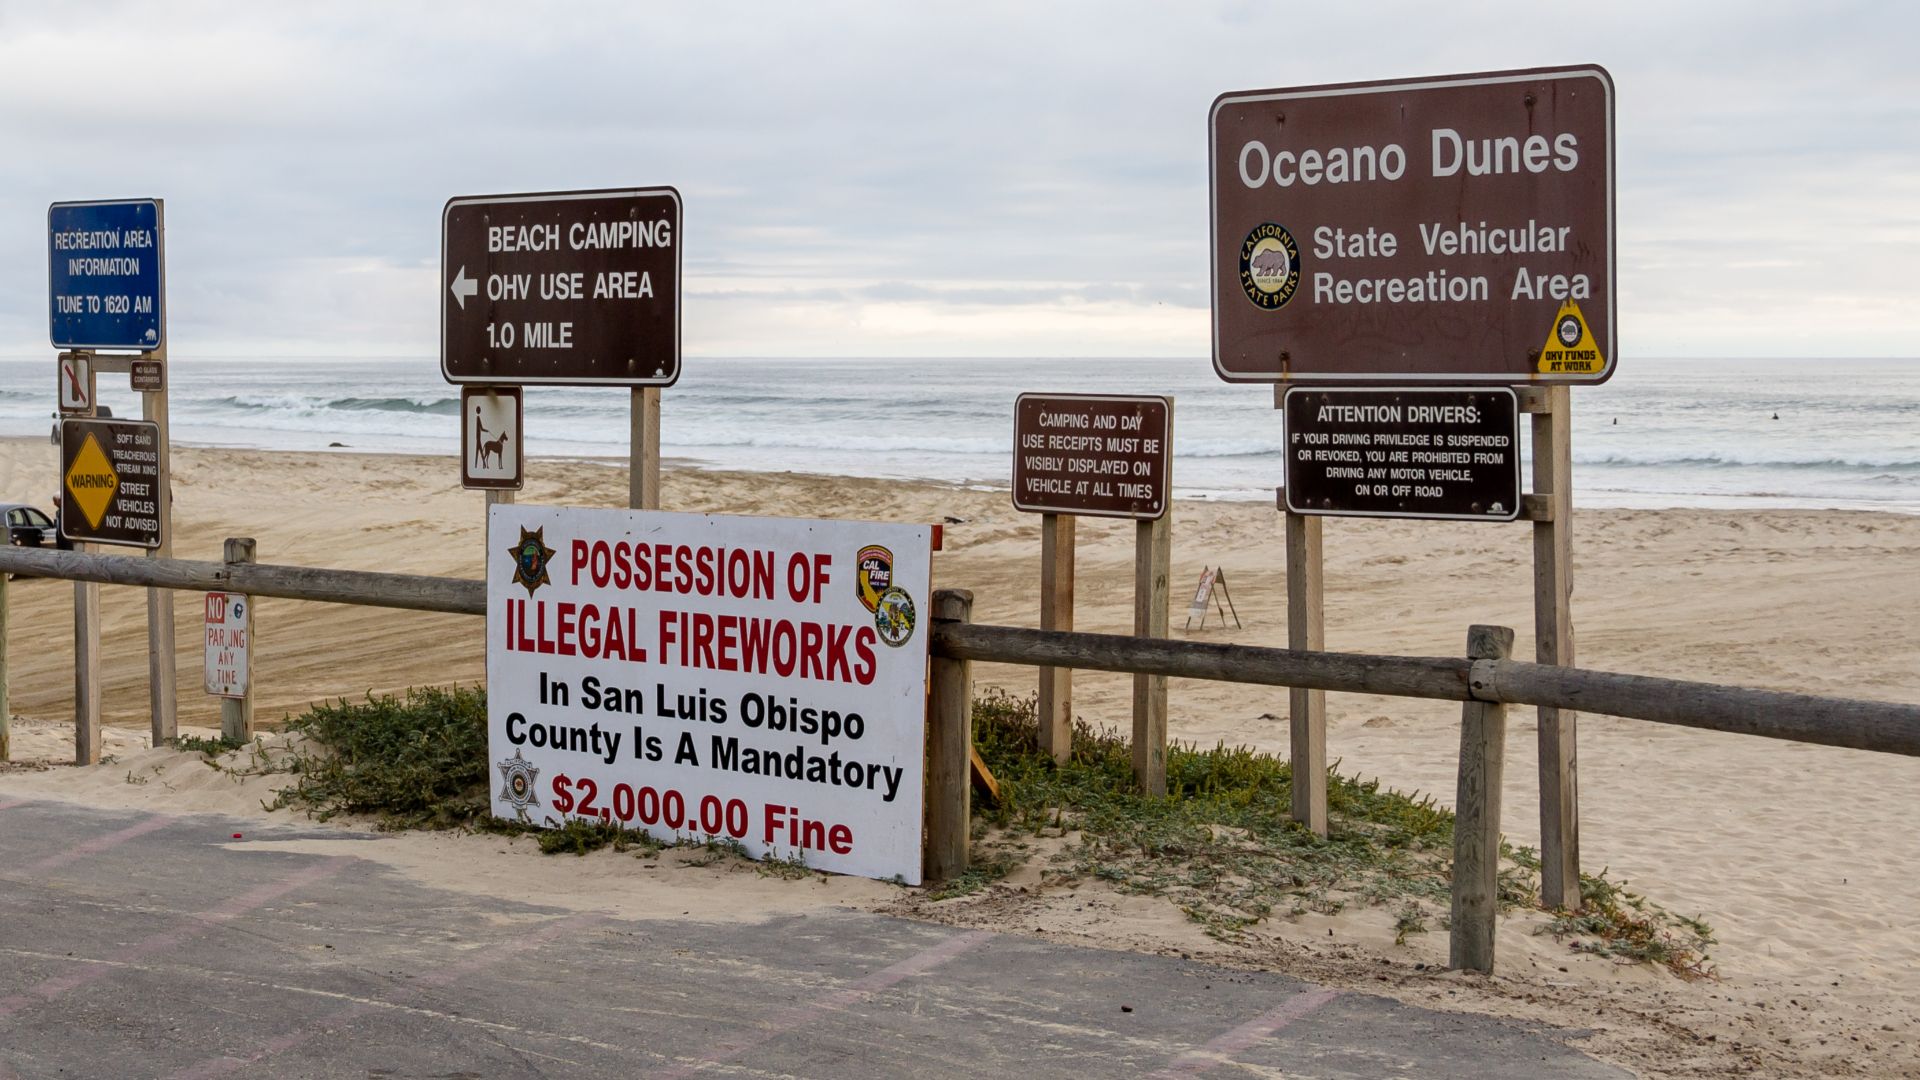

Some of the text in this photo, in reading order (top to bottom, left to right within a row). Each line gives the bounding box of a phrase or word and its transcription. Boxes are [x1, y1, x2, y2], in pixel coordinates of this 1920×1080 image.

[1239, 128, 1579, 189] Oceano Dunes
[56, 231, 152, 249] RECREATION AREA
[489, 220, 670, 252] BEACH CAMPING
[1242, 225, 1296, 260] CALIFORNIA
[1313, 220, 1570, 259] State Vehicular
[69, 258, 139, 275] INFORMATION
[487, 272, 653, 301] OHV USE AREA
[1242, 271, 1297, 305] STATE PARKS
[1314, 267, 1590, 303] Recreation Area
[57, 296, 151, 313] TUNE TO 1620 AM
[486, 322, 573, 348] 1.0 MILE
[1546, 351, 1596, 360] OHV FUNDS
[1551, 362, 1591, 371] AT WORK
[1039, 413, 1143, 430] CAMPING AND DAY
[1317, 406, 1481, 423] ATTENTION DRIVERS:
[117, 434, 151, 445] SOFT SAND
[1023, 434, 1159, 453] USE RECEIPTS MUST BE
[1292, 434, 1509, 447] IF YOUR DRIVING PRIVILEDGE IS SUSPENDED
[113, 450, 156, 461] TREACHEROUS
[1298, 450, 1503, 464] OR REVOKED, YOU ARE PROHIBITED FROM
[116, 464, 156, 475] STREAM XING
[1025, 456, 1150, 476] VISIBLY DISPLAYED ON
[71, 474, 114, 489] WARNING
[1326, 468, 1473, 482] DRIVING ANY MOTOR VEHICLE,
[120, 483, 149, 496] STREET
[1026, 478, 1152, 499] VEHICLE AT ALL TIMES
[1356, 485, 1442, 497] ON OR OFF ROAD
[117, 500, 154, 514] VEHICLES
[106, 515, 157, 531] NOT ADVISED
[571, 539, 775, 600] POSSESSION
[787, 552, 831, 603] OF
[863, 561, 879, 569] CAL
[870, 571, 890, 580] FIRE
[208, 597, 223, 619] NO
[209, 629, 244, 648] PARING
[506, 598, 877, 685] ILLEGAL FIREWORKS
[219, 652, 234, 665] ANY
[217, 669, 236, 684] TIME
[539, 672, 864, 744] In San Luis Obispo
[505, 712, 903, 801] County Is A Mandatory
[552, 774, 749, 838] $2,000.00
[764, 804, 853, 854] Fine
